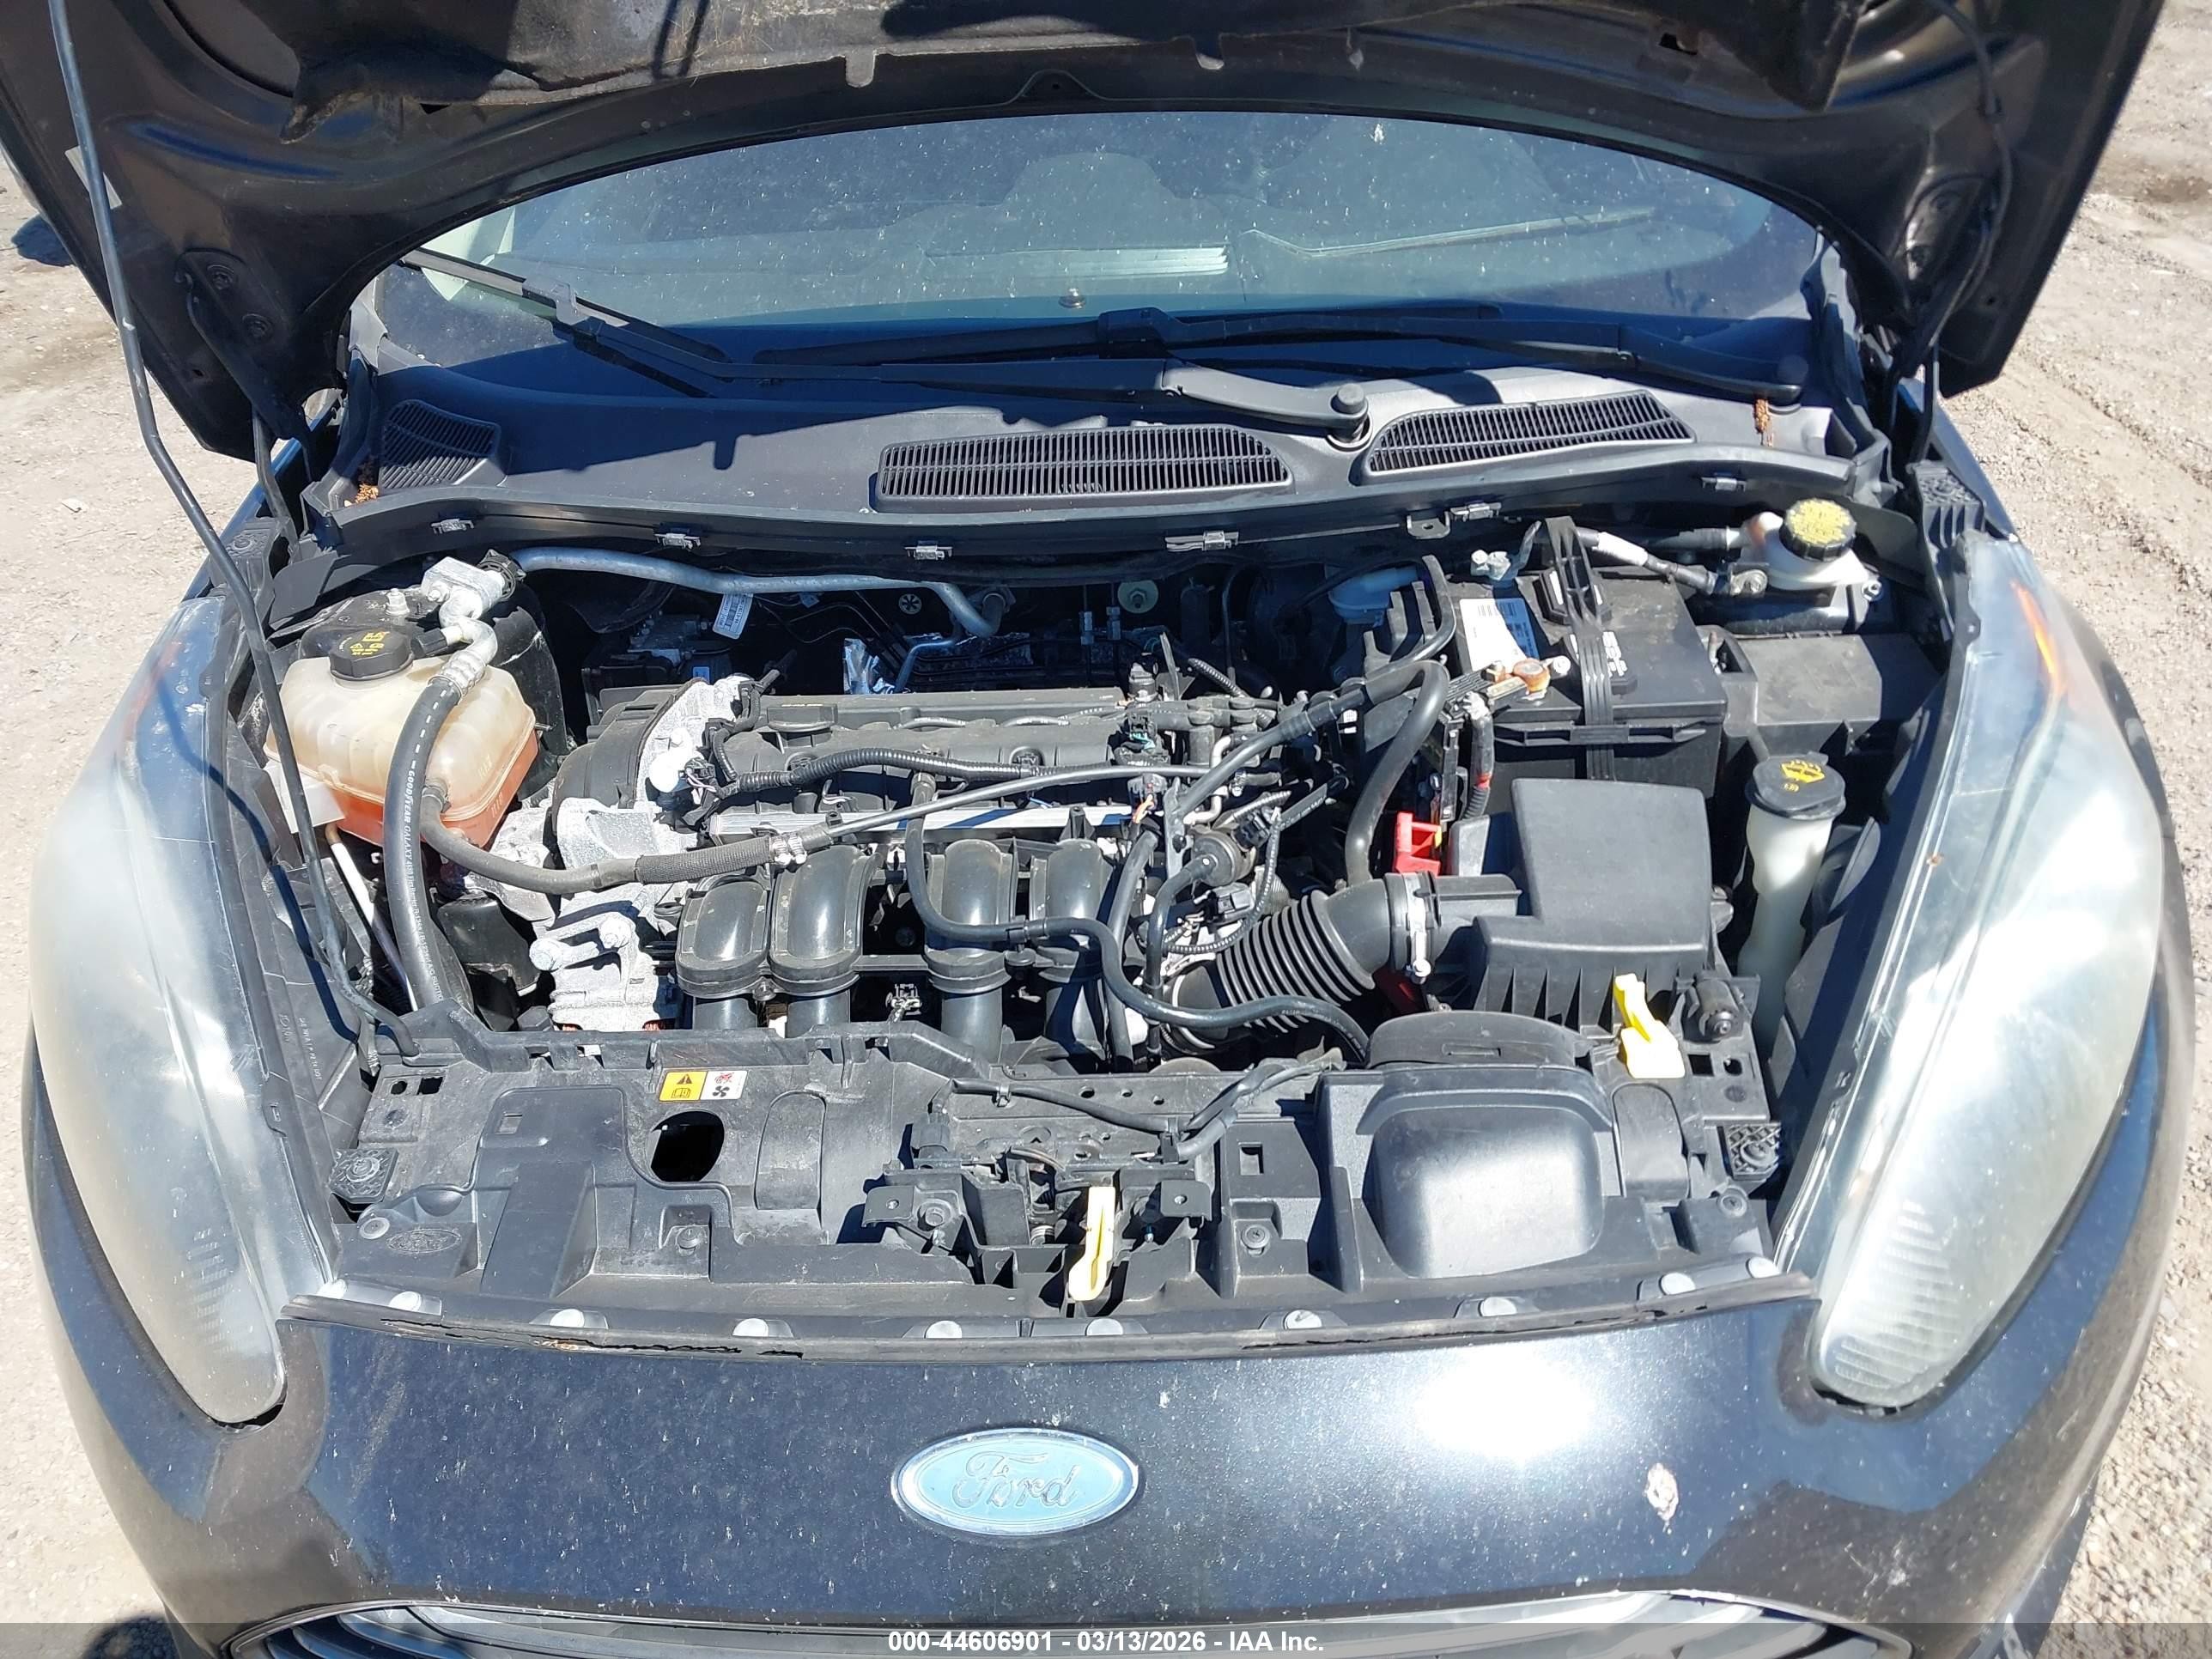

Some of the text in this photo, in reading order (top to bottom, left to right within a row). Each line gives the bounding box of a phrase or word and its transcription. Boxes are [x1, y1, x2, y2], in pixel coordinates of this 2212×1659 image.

[404, 770, 416, 823] GOODYEAR
[404, 825, 413, 862] GALAXY
[432, 975, 444, 1001] SUCTIO
[952, 1450, 1079, 1508] Ford
